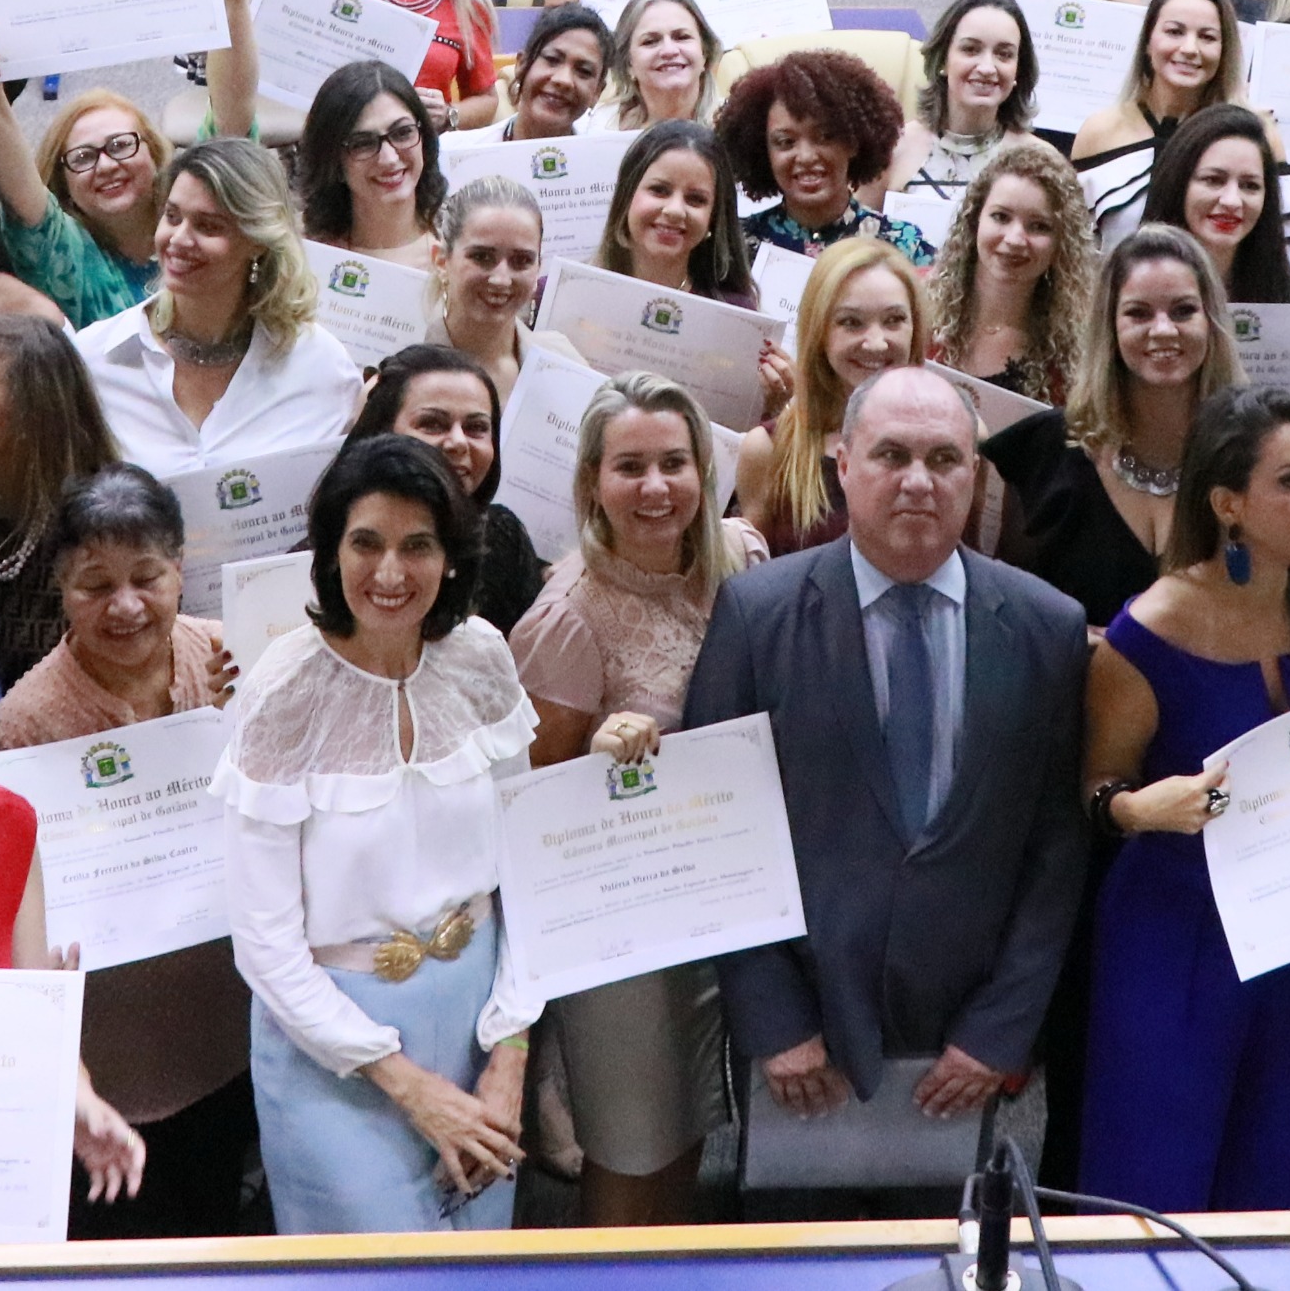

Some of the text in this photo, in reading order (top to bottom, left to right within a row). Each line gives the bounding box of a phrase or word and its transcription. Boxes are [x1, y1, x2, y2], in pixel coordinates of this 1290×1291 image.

[316, 18, 325, 27] de
[328, 22, 353, 38] Honra
[367, 38, 394, 53] Mérito
[573, 186, 585, 194] ao
[380, 315, 414, 332] Mérito
[272, 511, 285, 521] ao
[97, 776, 211, 810] Honra ao Mérito
[140, 800, 197, 820] de Goiânia
[542, 823, 596, 846] Diploma
[600, 818, 614, 830] de
[618, 807, 661, 825] Honra
[606, 825, 657, 847] Municipal
[130, 860, 140, 868] da
[168, 845, 197, 858] Castro
